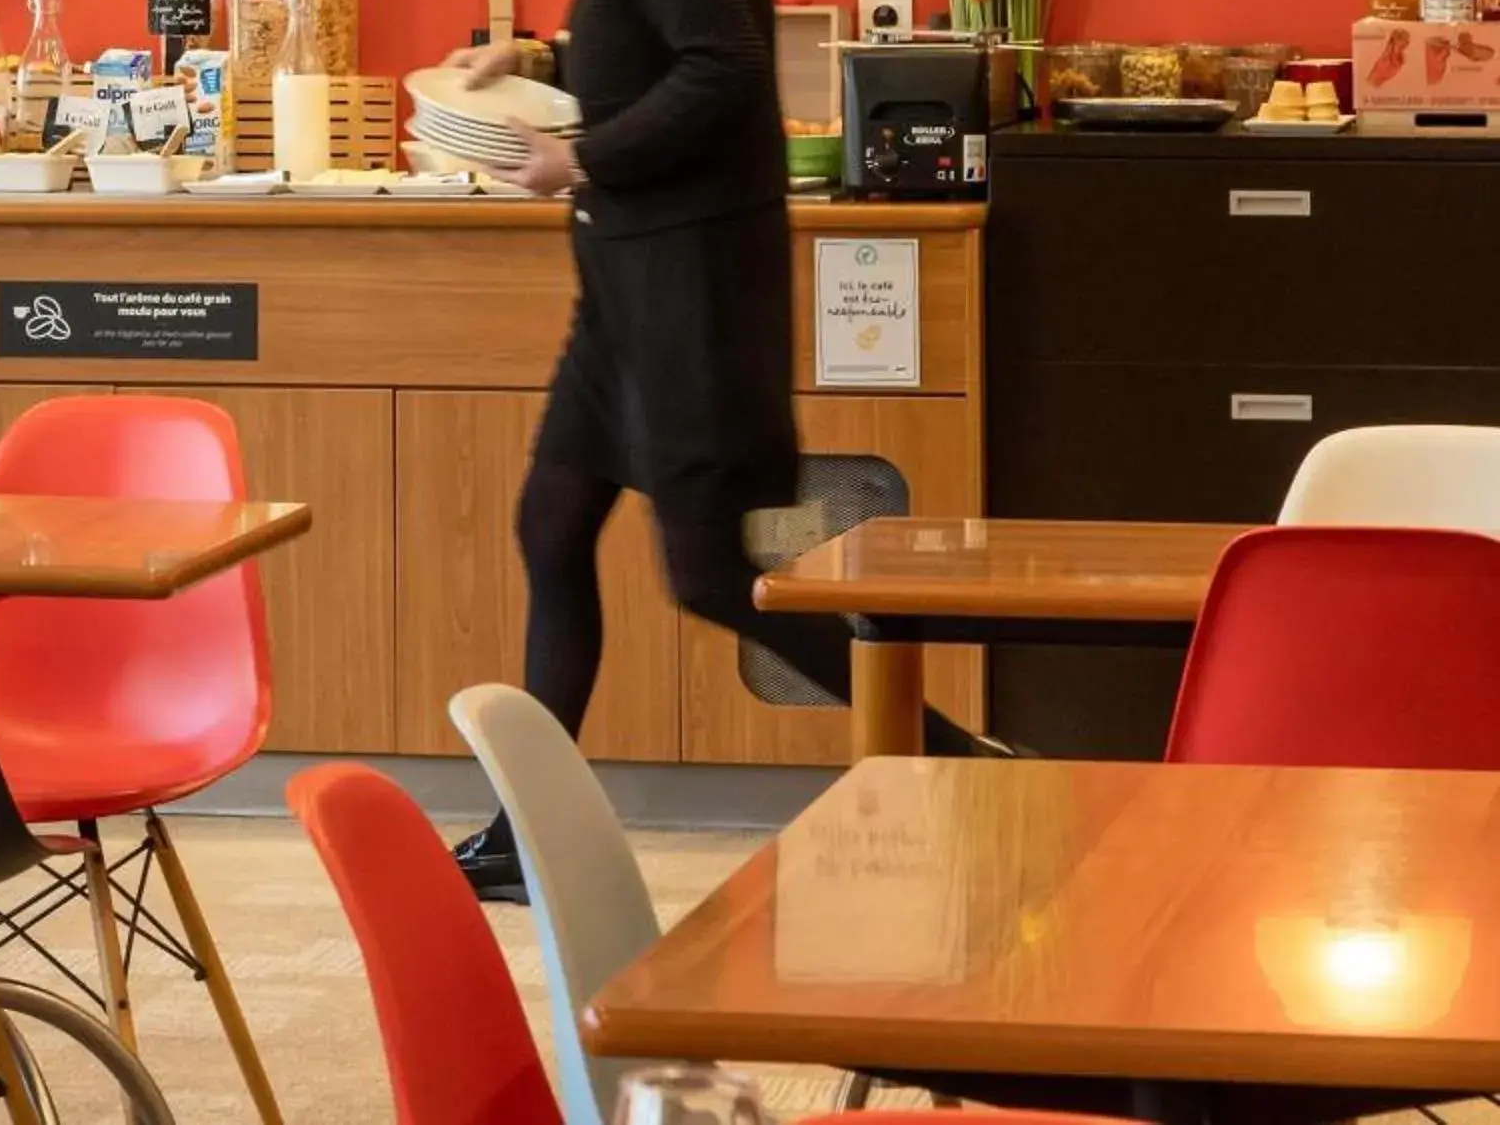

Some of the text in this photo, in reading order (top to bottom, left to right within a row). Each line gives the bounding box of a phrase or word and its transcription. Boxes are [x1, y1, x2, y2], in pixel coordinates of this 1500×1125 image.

[93, 292, 119, 303] Tout
[161, 292, 177, 303] du
[177, 292, 202, 303] café
[203, 293, 232, 305] grain
[153, 308, 179, 320] pour
[180, 308, 207, 317] vous
